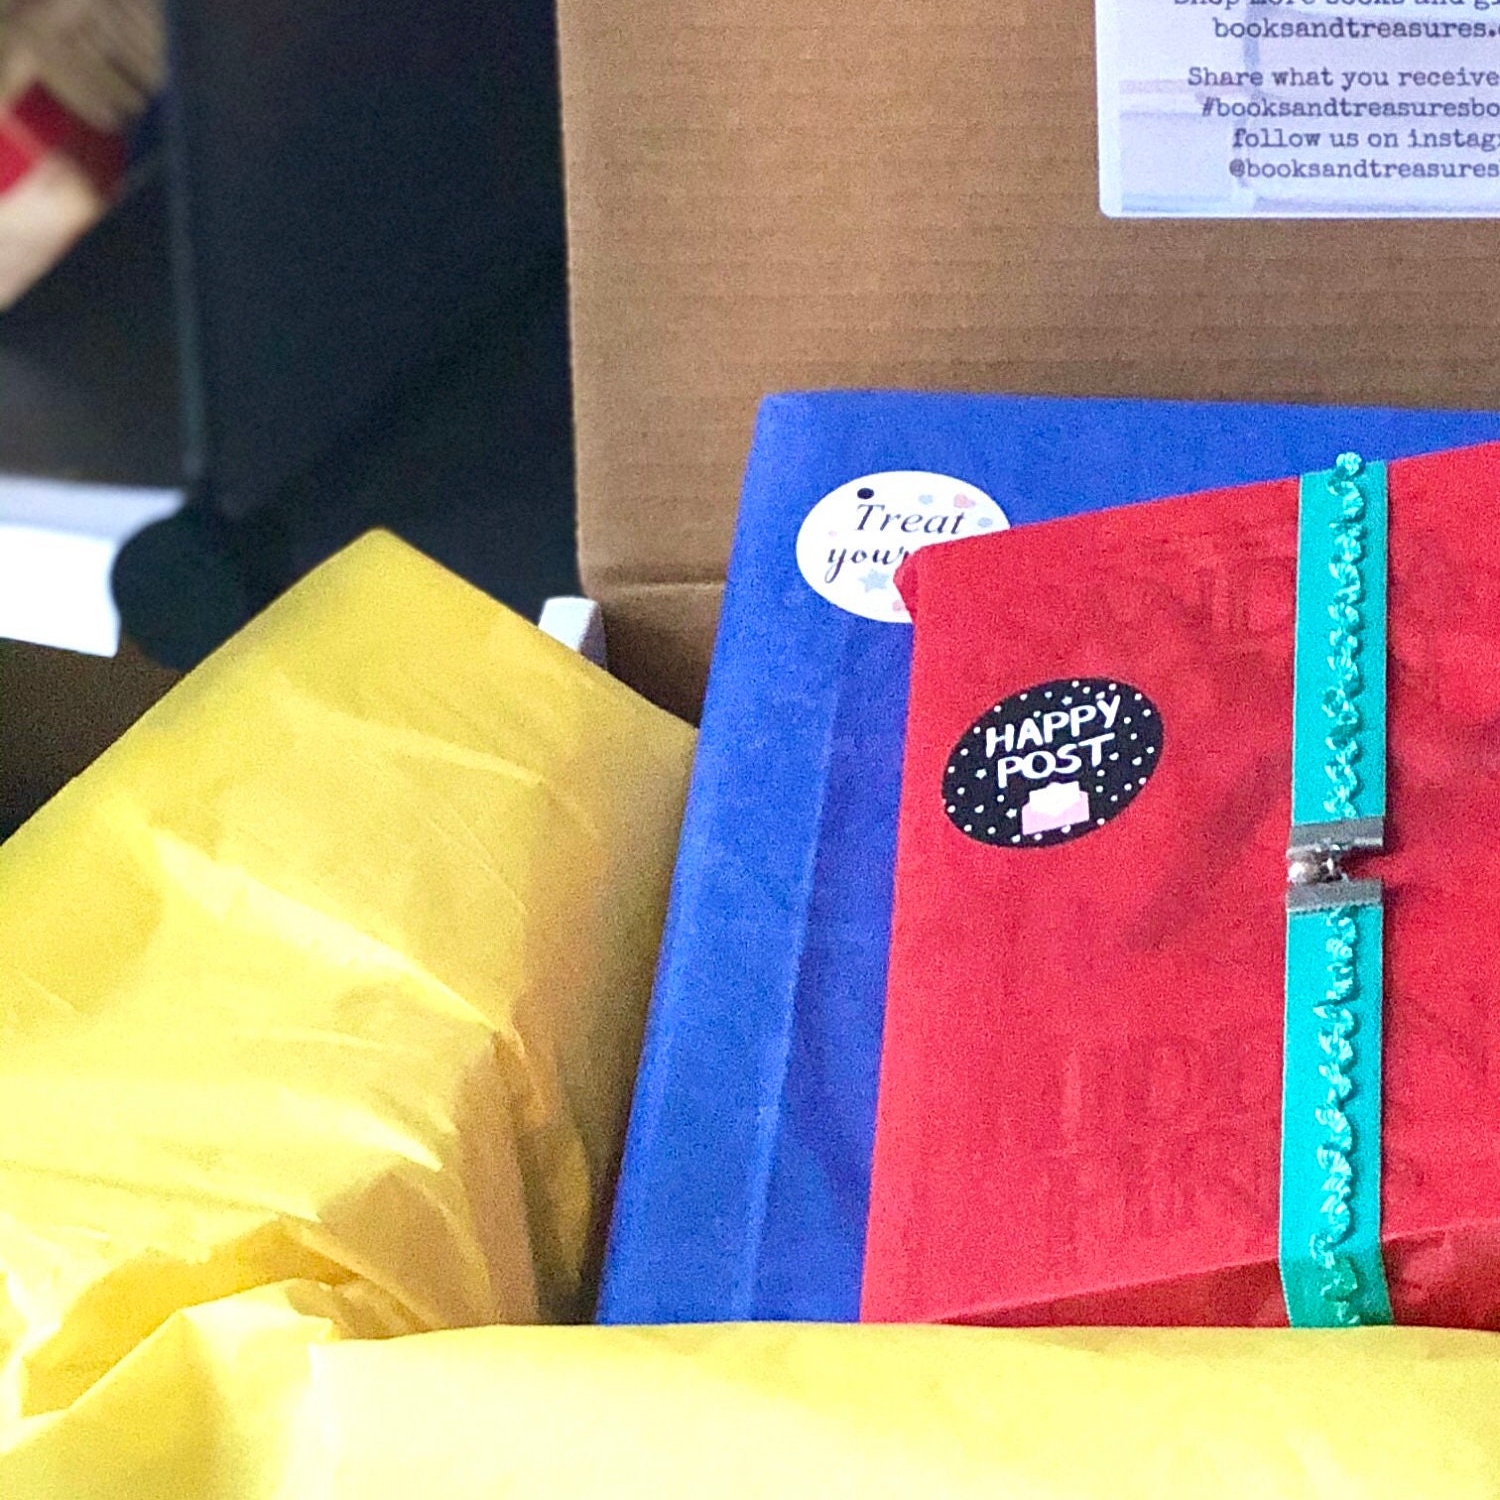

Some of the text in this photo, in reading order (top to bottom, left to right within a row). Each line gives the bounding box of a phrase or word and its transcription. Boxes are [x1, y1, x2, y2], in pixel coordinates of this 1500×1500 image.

[1187, 66, 1264, 88] Share
[1272, 66, 1334, 87] what
[1341, 69, 1390, 94] you
[1231, 127, 1321, 150] follow
[1330, 132, 1360, 149] us
[1366, 132, 1399, 149] on
[855, 503, 967, 535] Treat
[985, 694, 1121, 758] HAPPY
[997, 733, 1116, 788] POST
